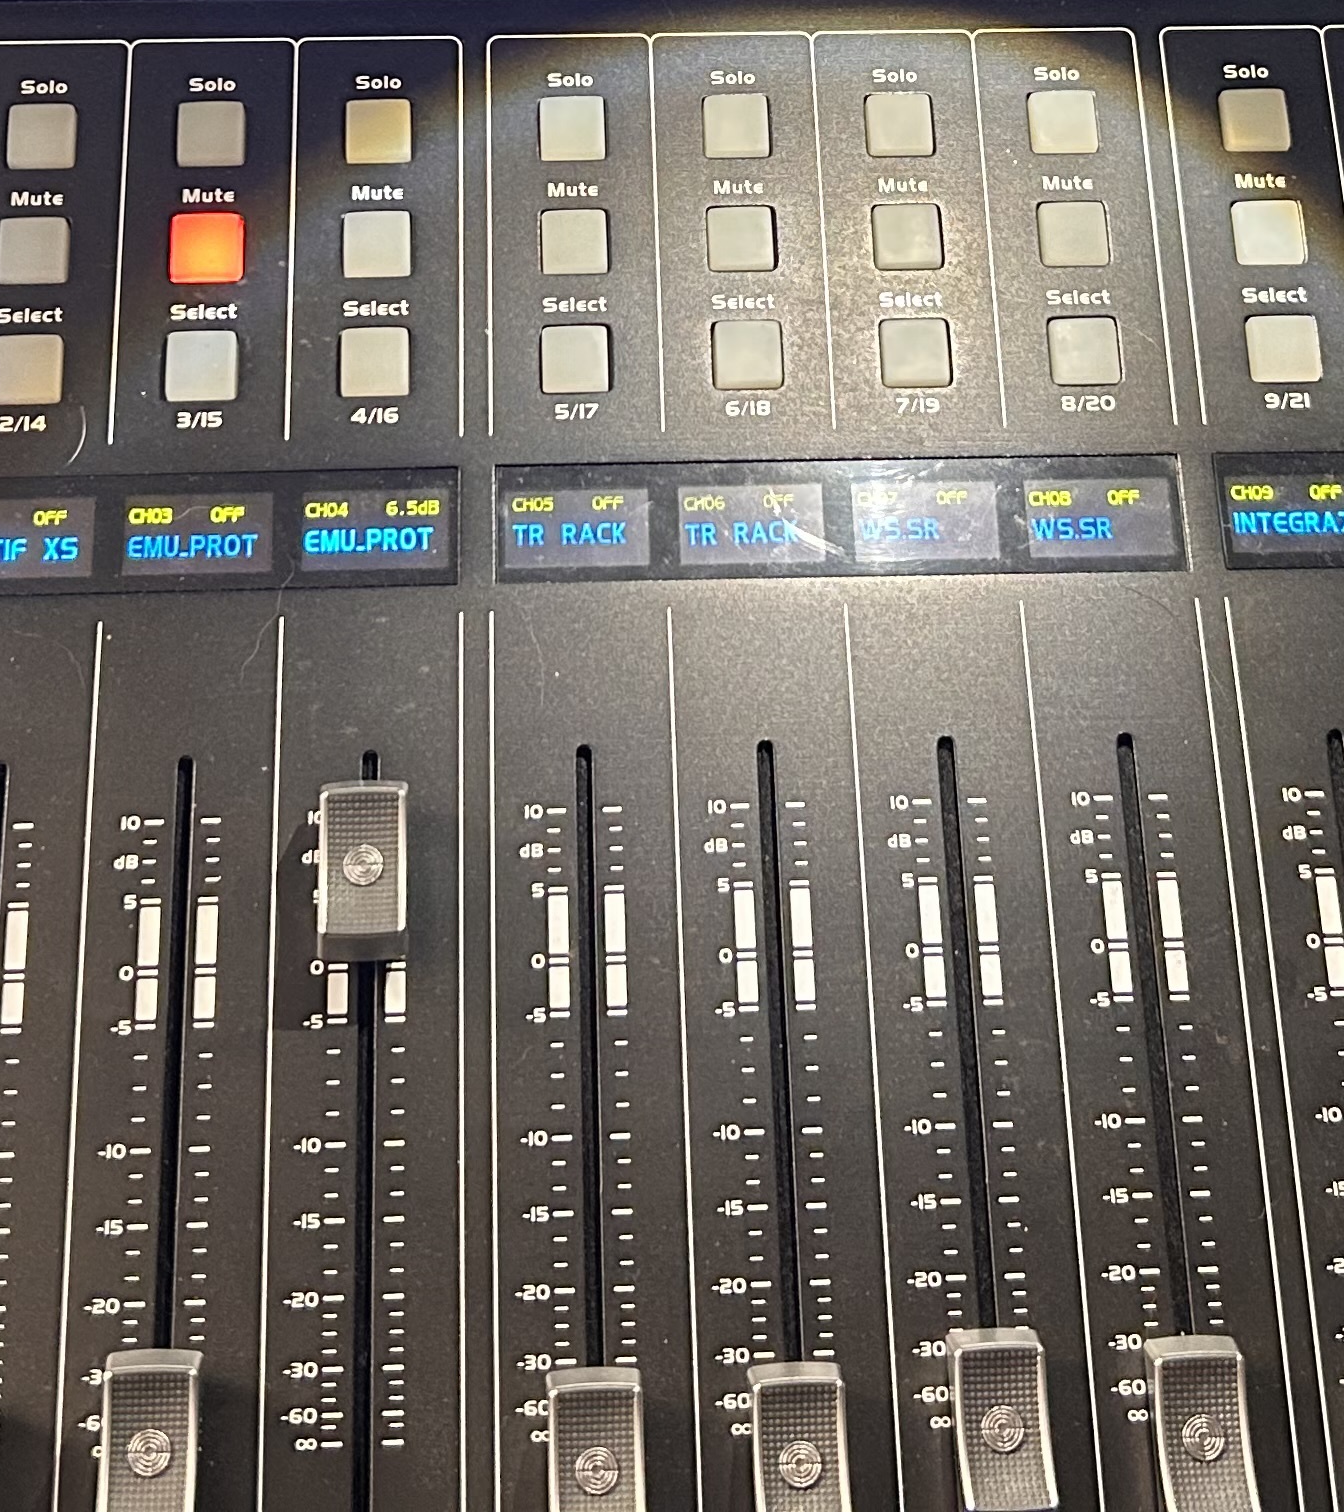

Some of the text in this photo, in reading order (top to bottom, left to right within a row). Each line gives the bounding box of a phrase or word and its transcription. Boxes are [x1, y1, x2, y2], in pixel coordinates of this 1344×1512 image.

[343, 300, 409, 316] Select
[726, 400, 770, 417] 6/18
[1061, 395, 1115, 412] 8/20
[1265, 392, 1310, 409] 9/21
[177, 411, 222, 429] 3/15
[351, 407, 398, 424] 4/16
[555, 403, 599, 420] 5/17
[0, 416, 46, 432] 2/14
[1231, 485, 1343, 500] CH09 OFF
[305, 500, 439, 518] CH04 6.5dB
[512, 496, 624, 512] CH05 OFF
[512, 522, 626, 547] TR RACK
[1027, 512, 1113, 545] WS.SR
[293, 1138, 321, 1153] -10
[283, 1362, 318, 1378] -30
[281, 1408, 317, 1424] -60
